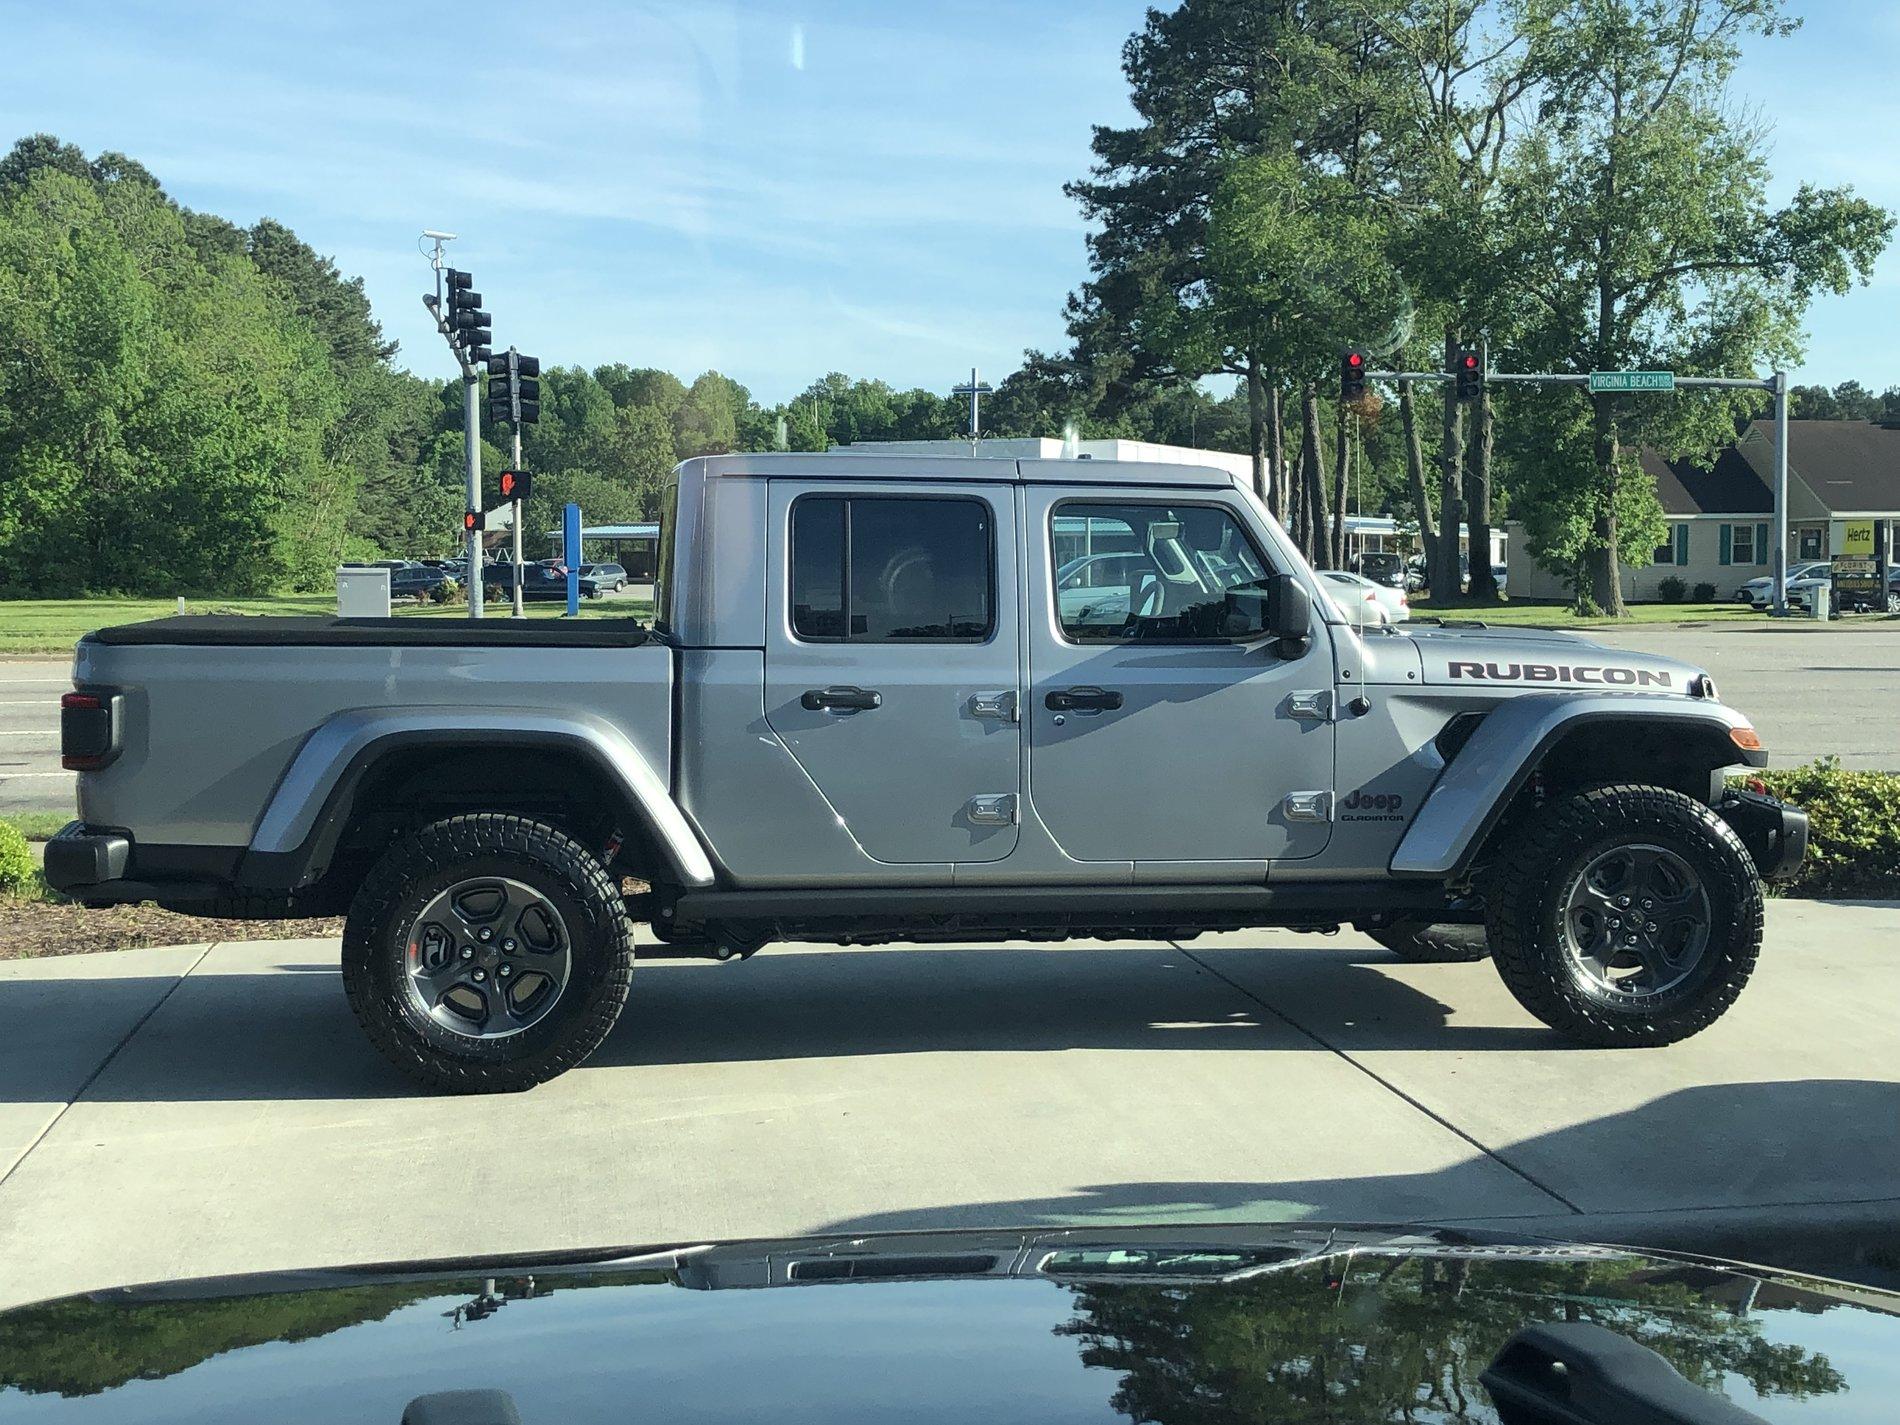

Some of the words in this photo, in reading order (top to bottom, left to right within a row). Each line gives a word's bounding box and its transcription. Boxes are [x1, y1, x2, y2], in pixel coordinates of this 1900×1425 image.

[1592, 375, 1628, 387] VIRGINIA
[1630, 375, 1658, 387] BEACH
[1847, 527, 1871, 541] Hertz
[1447, 661, 1672, 687] RUBICON
[1344, 789, 1402, 813] Jeep
